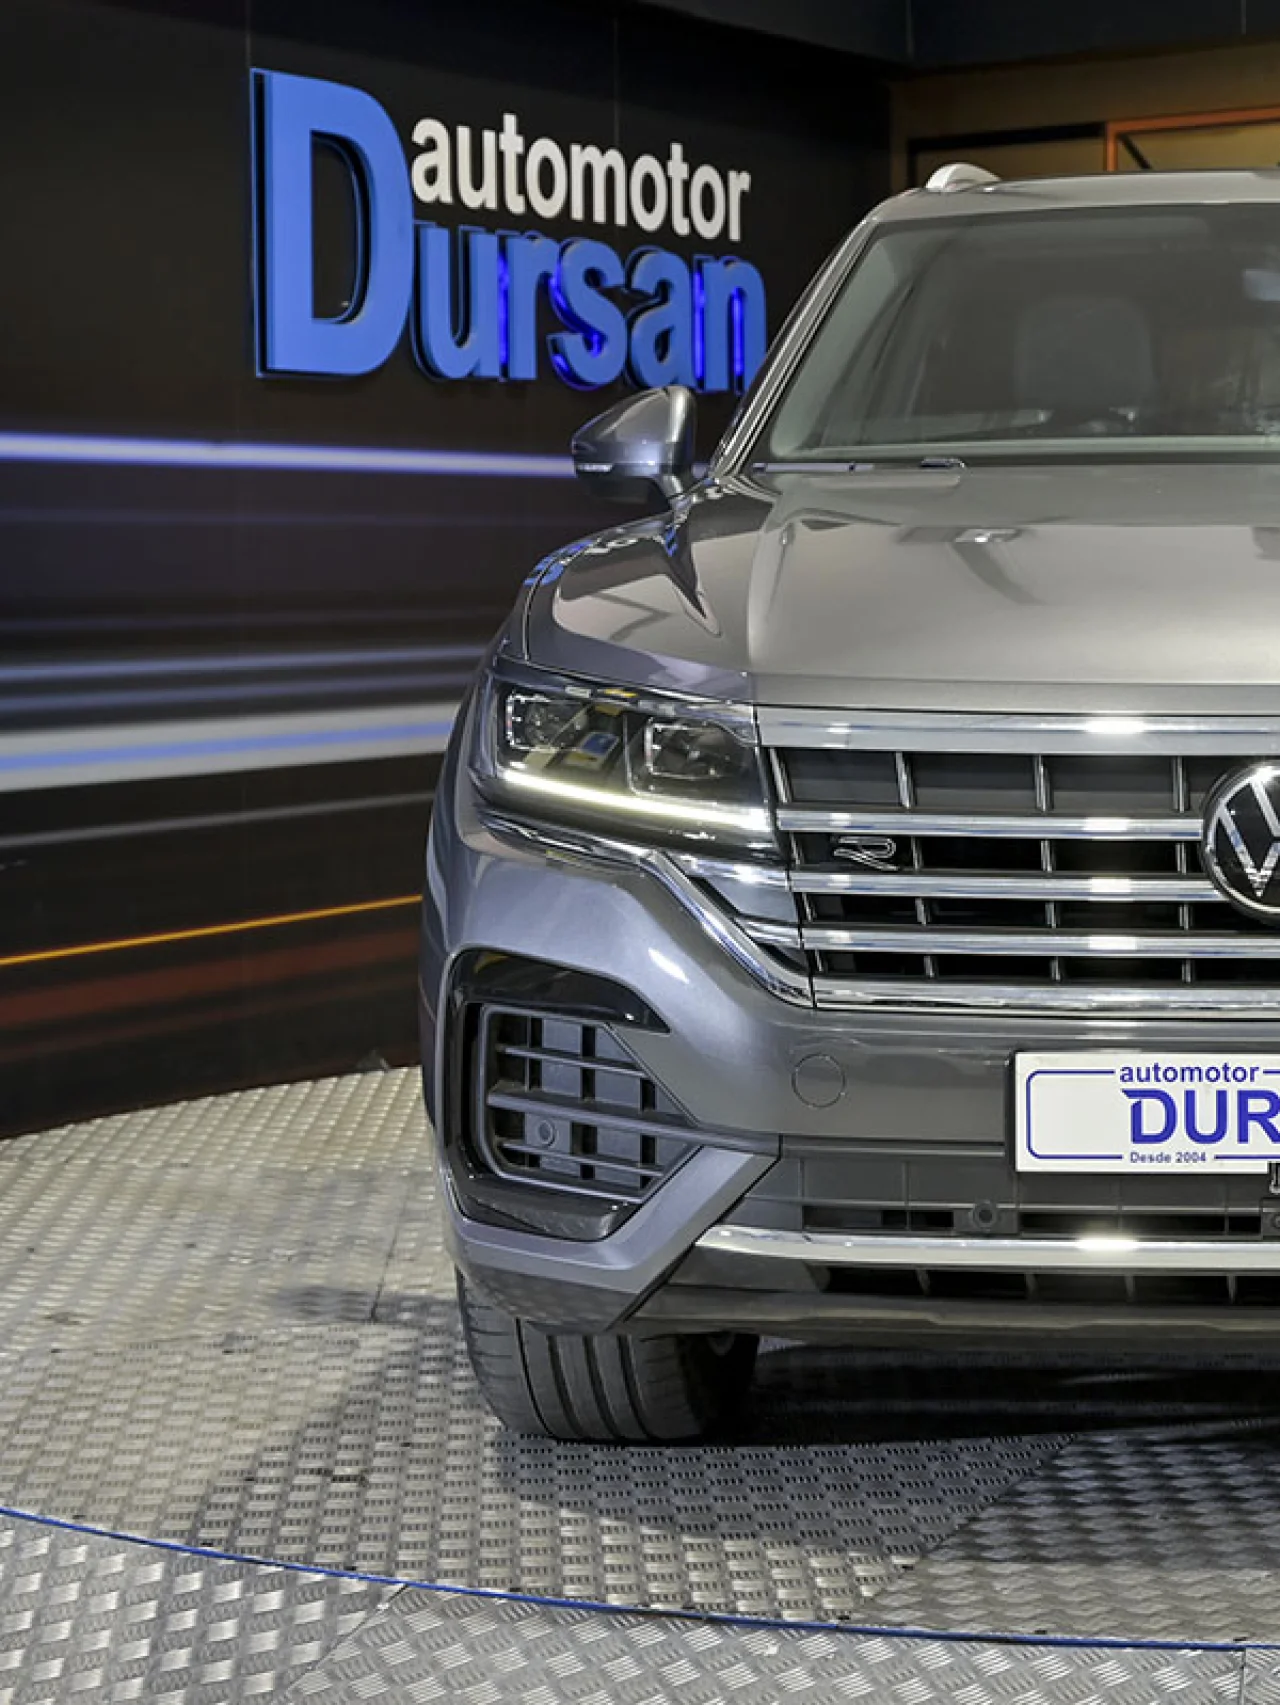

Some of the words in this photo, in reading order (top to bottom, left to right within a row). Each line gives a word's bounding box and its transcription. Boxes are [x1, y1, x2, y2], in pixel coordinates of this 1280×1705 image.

[411, 112, 751, 242] automotor
[250, 67, 767, 393] Dursan
[1119, 1062, 1260, 1083] automotor
[1129, 1151, 1172, 1164] Desde
[1174, 1151, 1207, 1164] 2004
